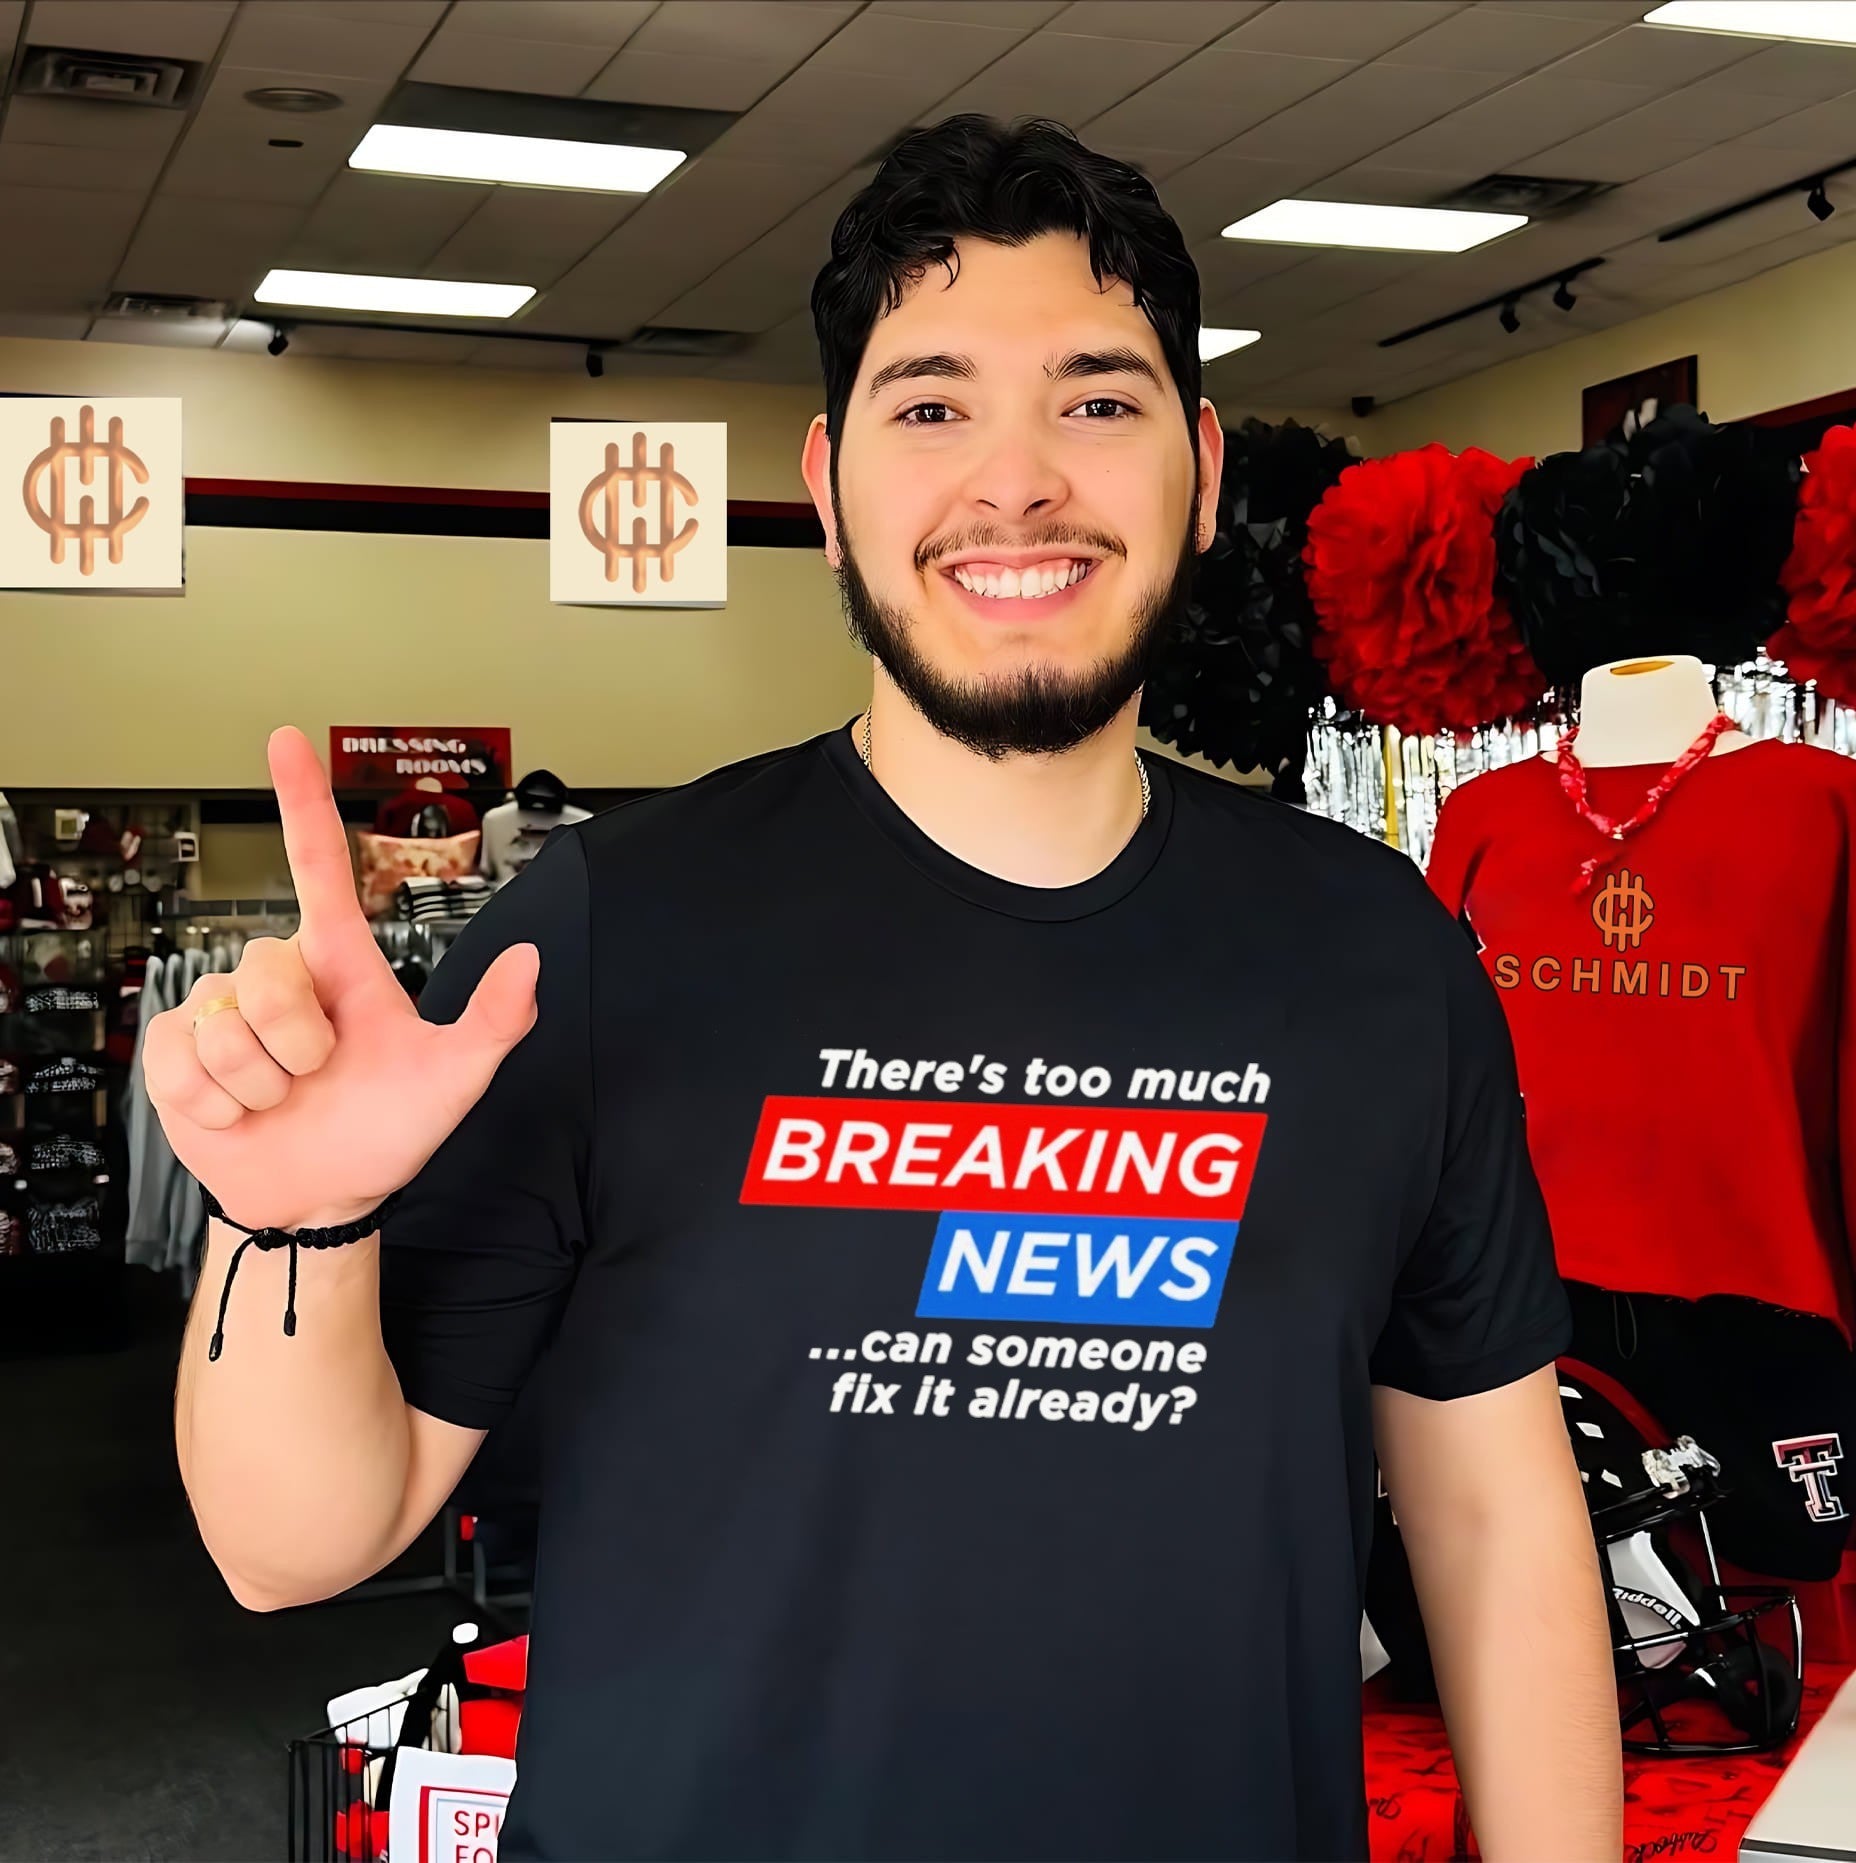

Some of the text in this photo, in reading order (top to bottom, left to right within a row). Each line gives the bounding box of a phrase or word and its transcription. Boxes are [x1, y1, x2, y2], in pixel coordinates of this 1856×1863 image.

[396, 758, 487, 775] ROOMS
[1494, 954, 1747, 1000] SCHMIDT
[819, 1048, 1271, 1104] There's too much
[763, 1118, 1242, 1197] BREAKING
[938, 1229, 1218, 1301] NEWS
[808, 1330, 1207, 1374] ...can someone
[829, 1372, 1197, 1432] fix it already?
